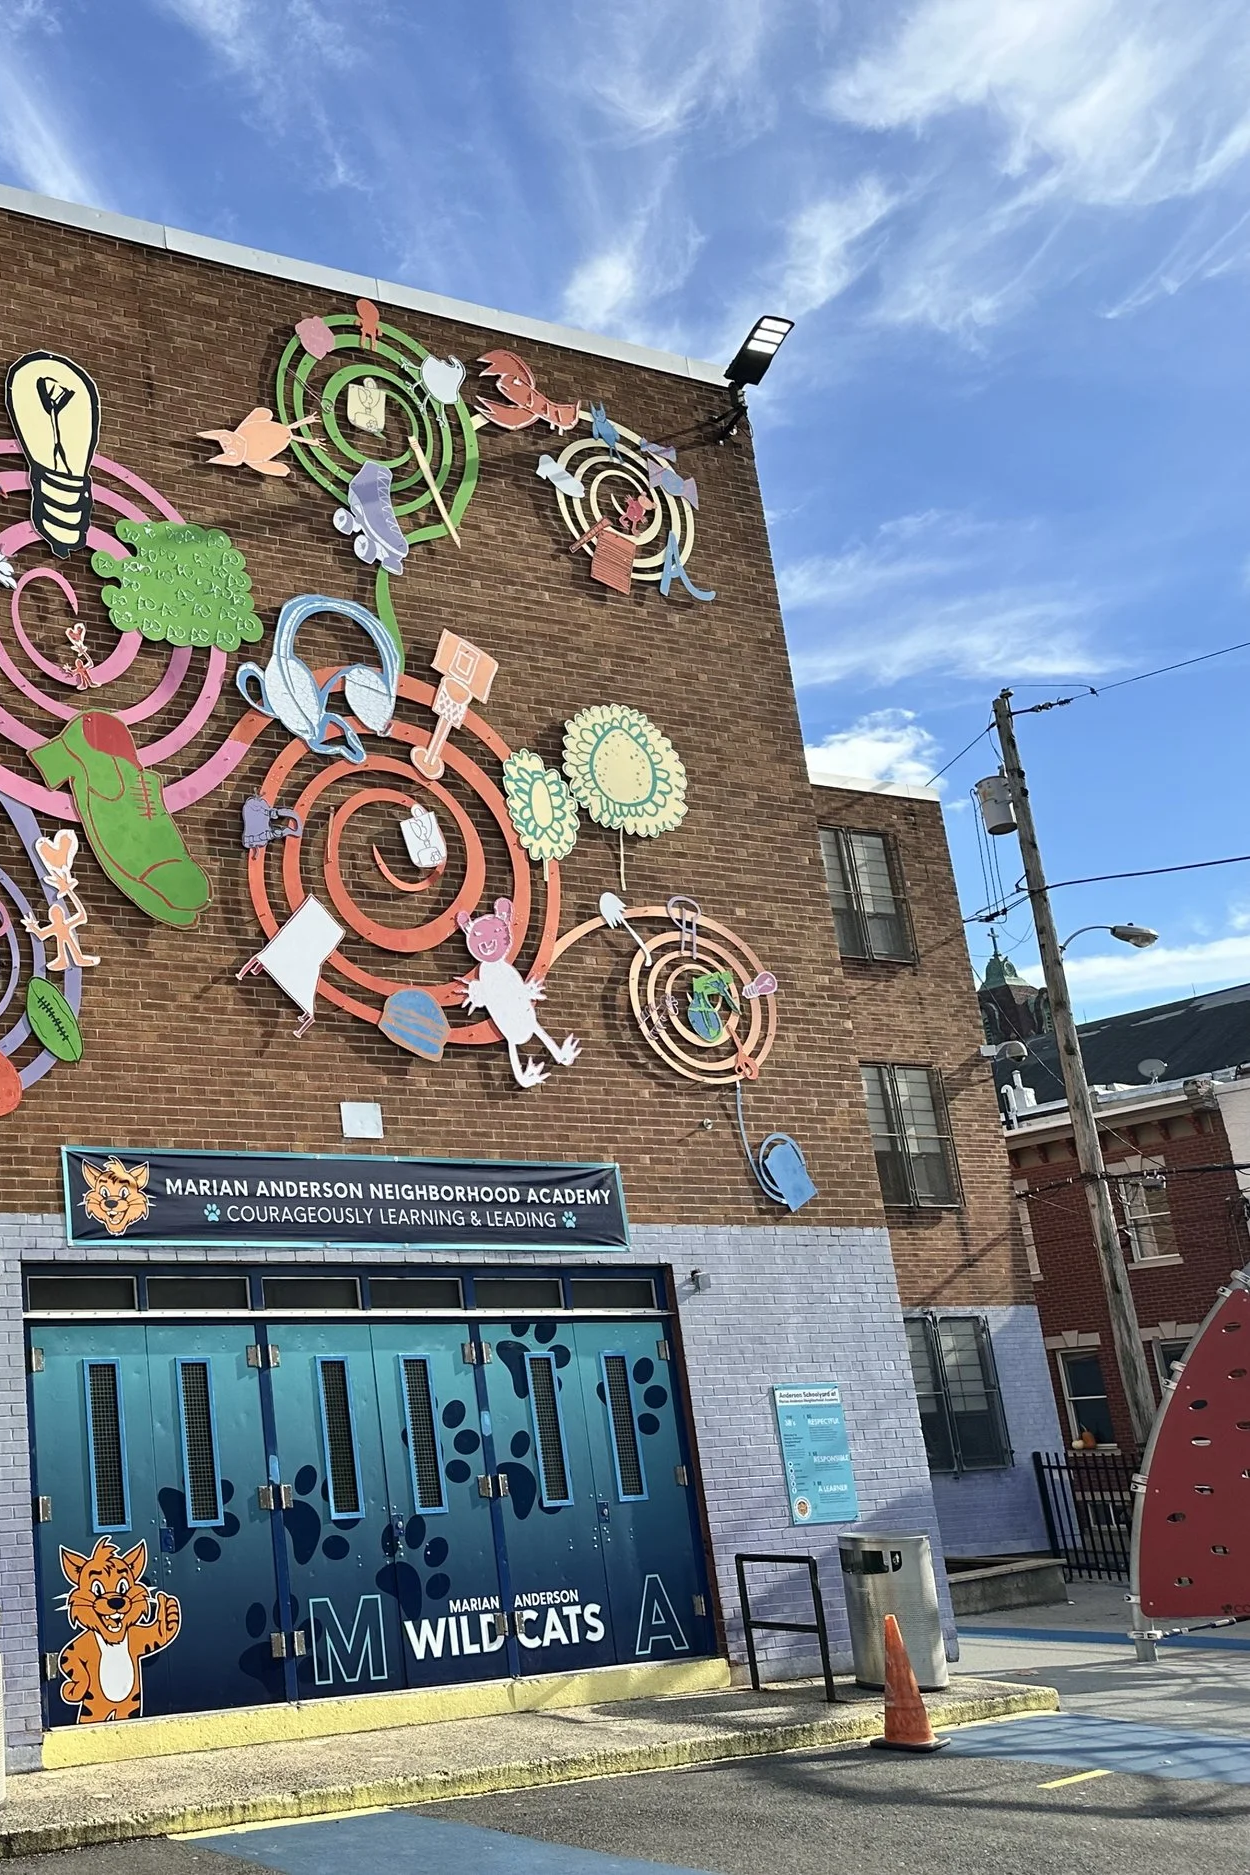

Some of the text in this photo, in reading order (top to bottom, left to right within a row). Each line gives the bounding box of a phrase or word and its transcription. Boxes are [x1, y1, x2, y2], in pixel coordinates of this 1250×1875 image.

[165, 1178, 611, 1205] MARIAN ANDERSON NEIGHBORHOOD ACADEMY
[226, 1205, 557, 1228] COURAGEOUSLY LEARNING & LEADING
[449, 1589, 579, 1613] MARIAN ANDERSON
[635, 1574, 689, 1655] A
[308, 1594, 389, 1685] M
